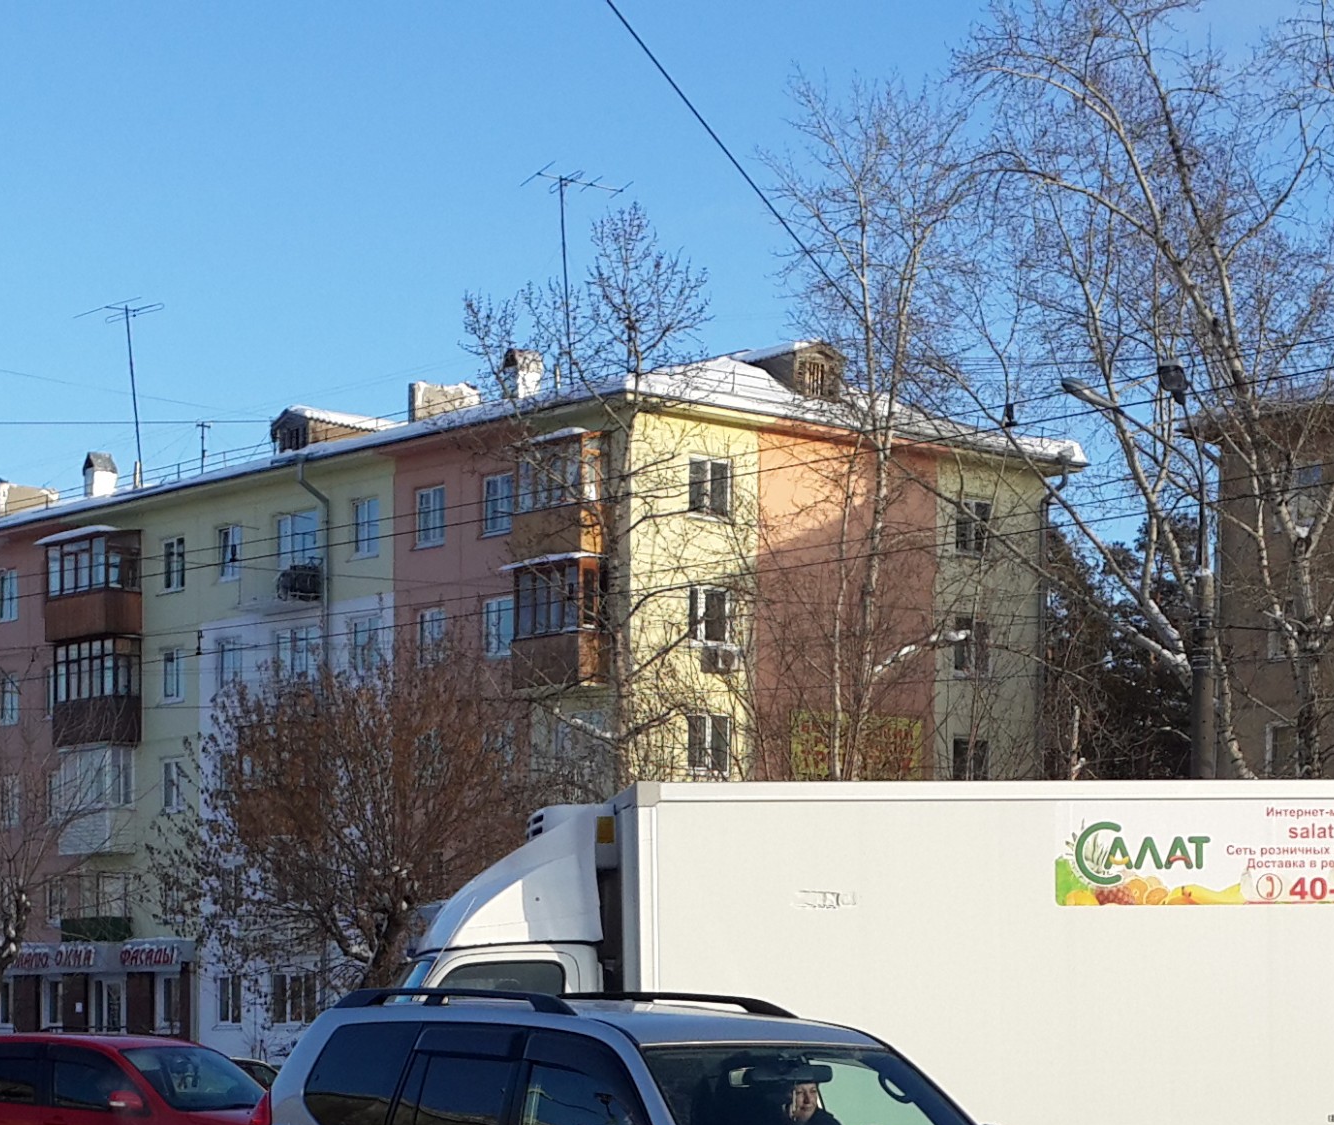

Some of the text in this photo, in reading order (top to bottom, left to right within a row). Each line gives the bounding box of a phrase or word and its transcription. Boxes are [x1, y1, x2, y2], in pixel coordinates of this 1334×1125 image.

[1226, 844, 1256, 857] Сеть
[1260, 845, 1331, 858] розничных
[1247, 857, 1306, 871] Доставка
[1310, 860, 1318, 869] в
[54, 946, 94, 968] ОКНА
[120, 945, 177, 966] ФАСАДЫ
